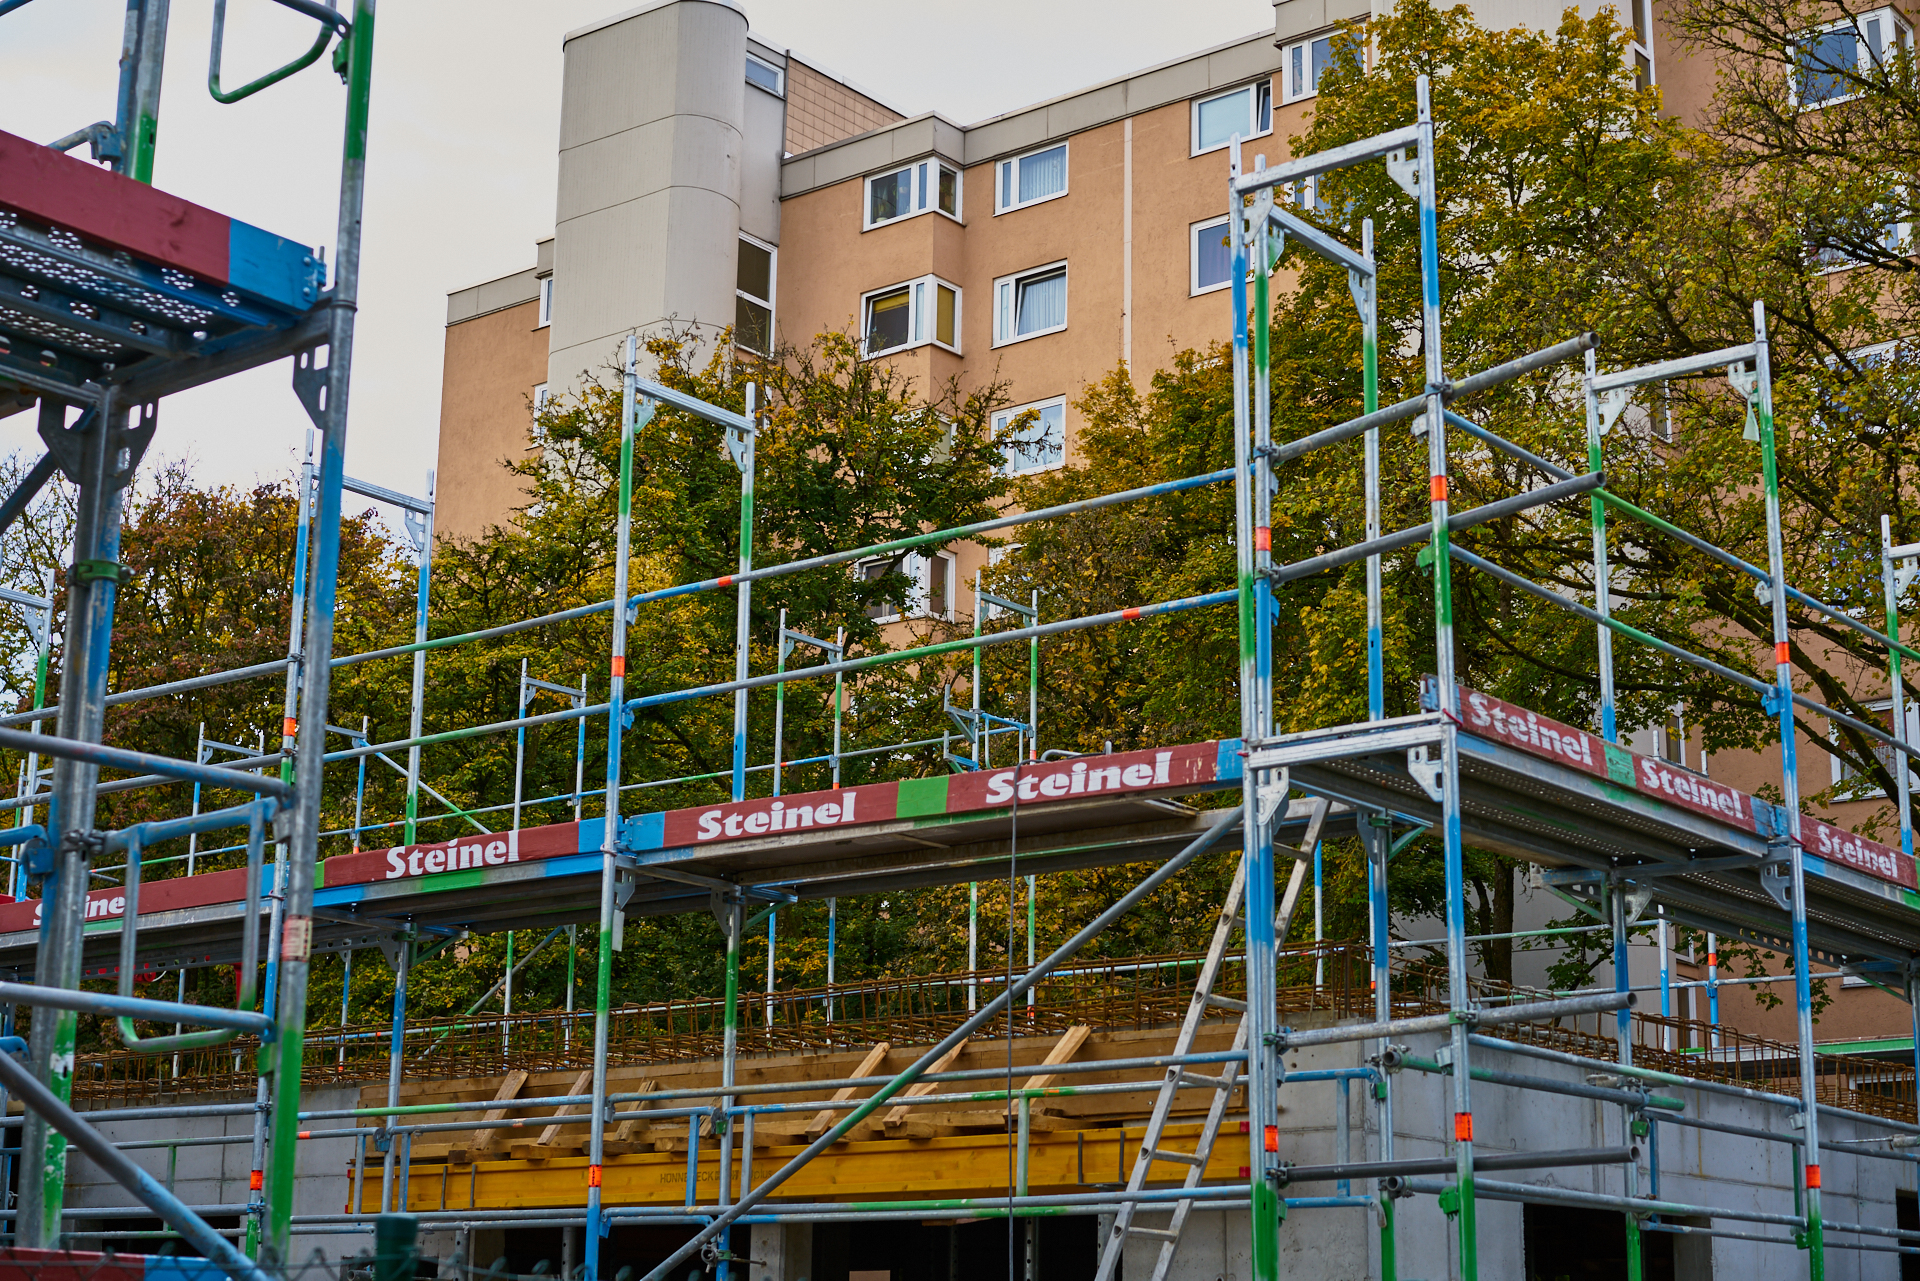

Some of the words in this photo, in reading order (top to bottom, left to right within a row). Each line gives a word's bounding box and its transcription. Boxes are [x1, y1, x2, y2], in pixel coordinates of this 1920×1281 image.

[1468, 692, 1593, 766] Steinel
[986, 751, 1173, 804] Steinel
[1641, 758, 1744, 820] Steinel
[697, 791, 857, 840] Steinel
[386, 829, 520, 879] Steinel
[1817, 824, 1898, 879] Steinel
[32, 894, 126, 926] Sine
